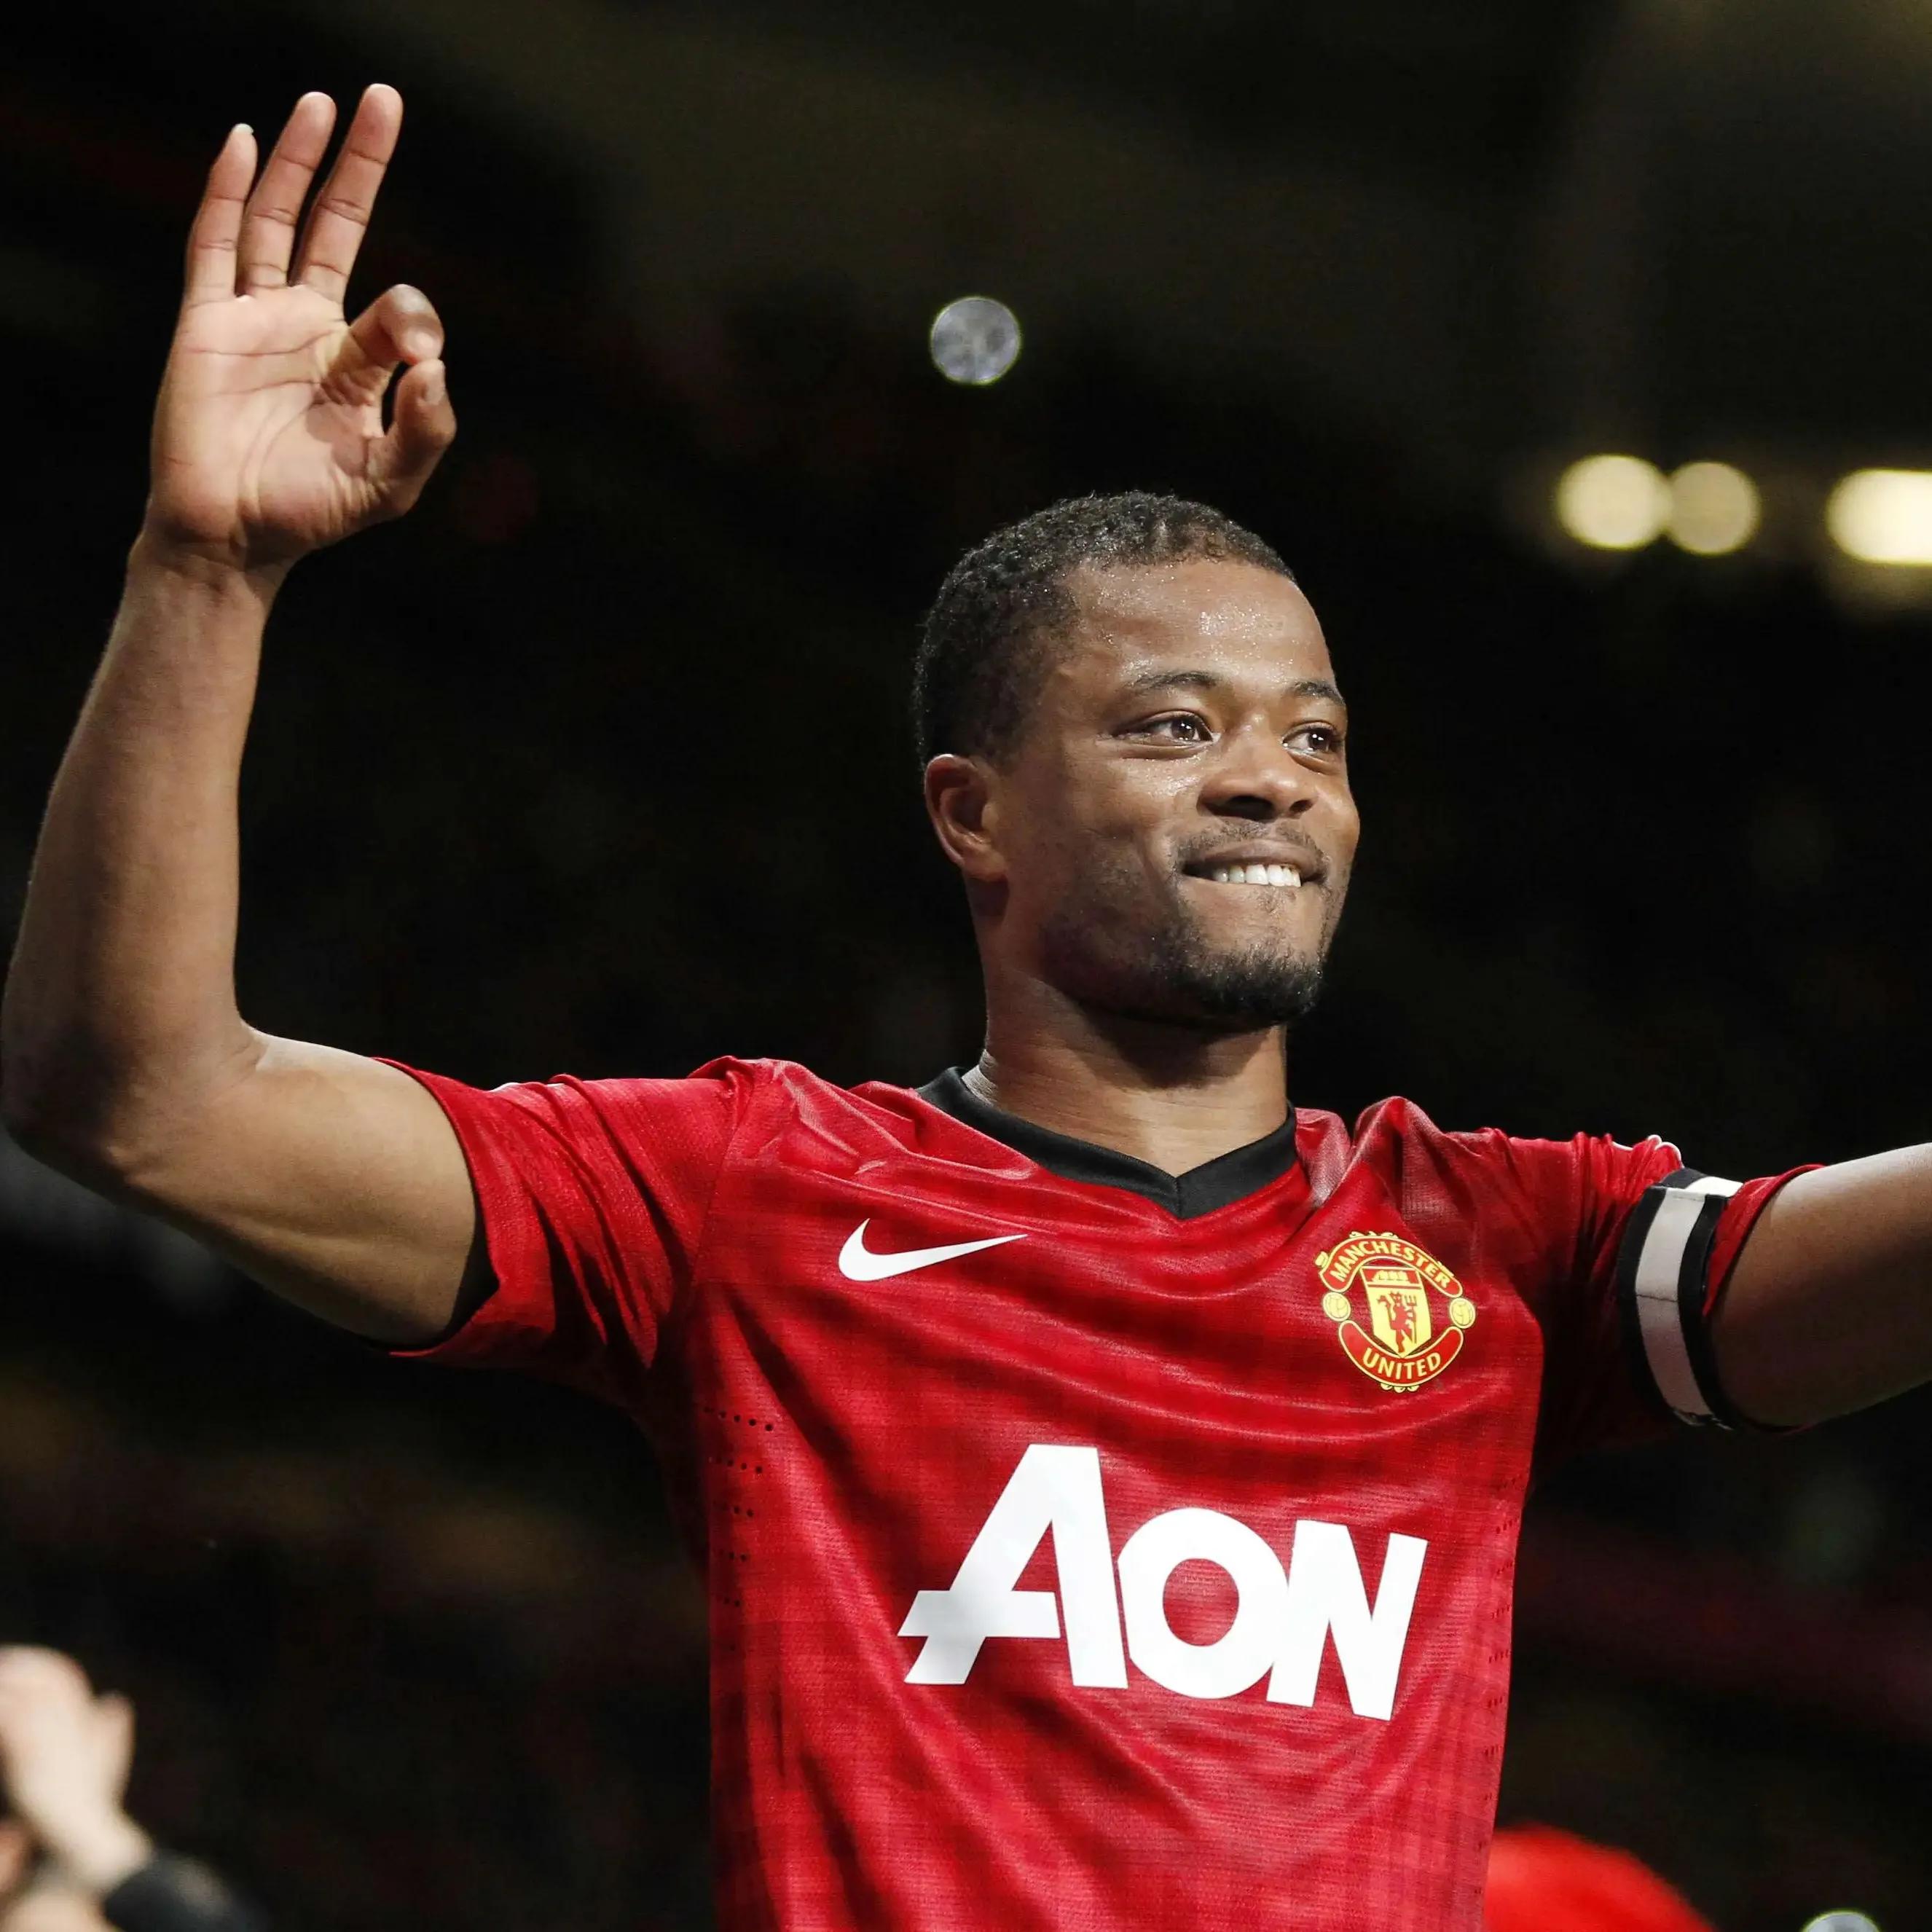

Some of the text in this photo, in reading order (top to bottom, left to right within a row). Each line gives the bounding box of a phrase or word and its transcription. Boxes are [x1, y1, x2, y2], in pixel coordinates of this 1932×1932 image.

[1330, 1241, 1450, 1288] MANCHESTER
[1362, 1348, 1441, 1379] UNITED
[898, 1445, 1428, 1721] AON
